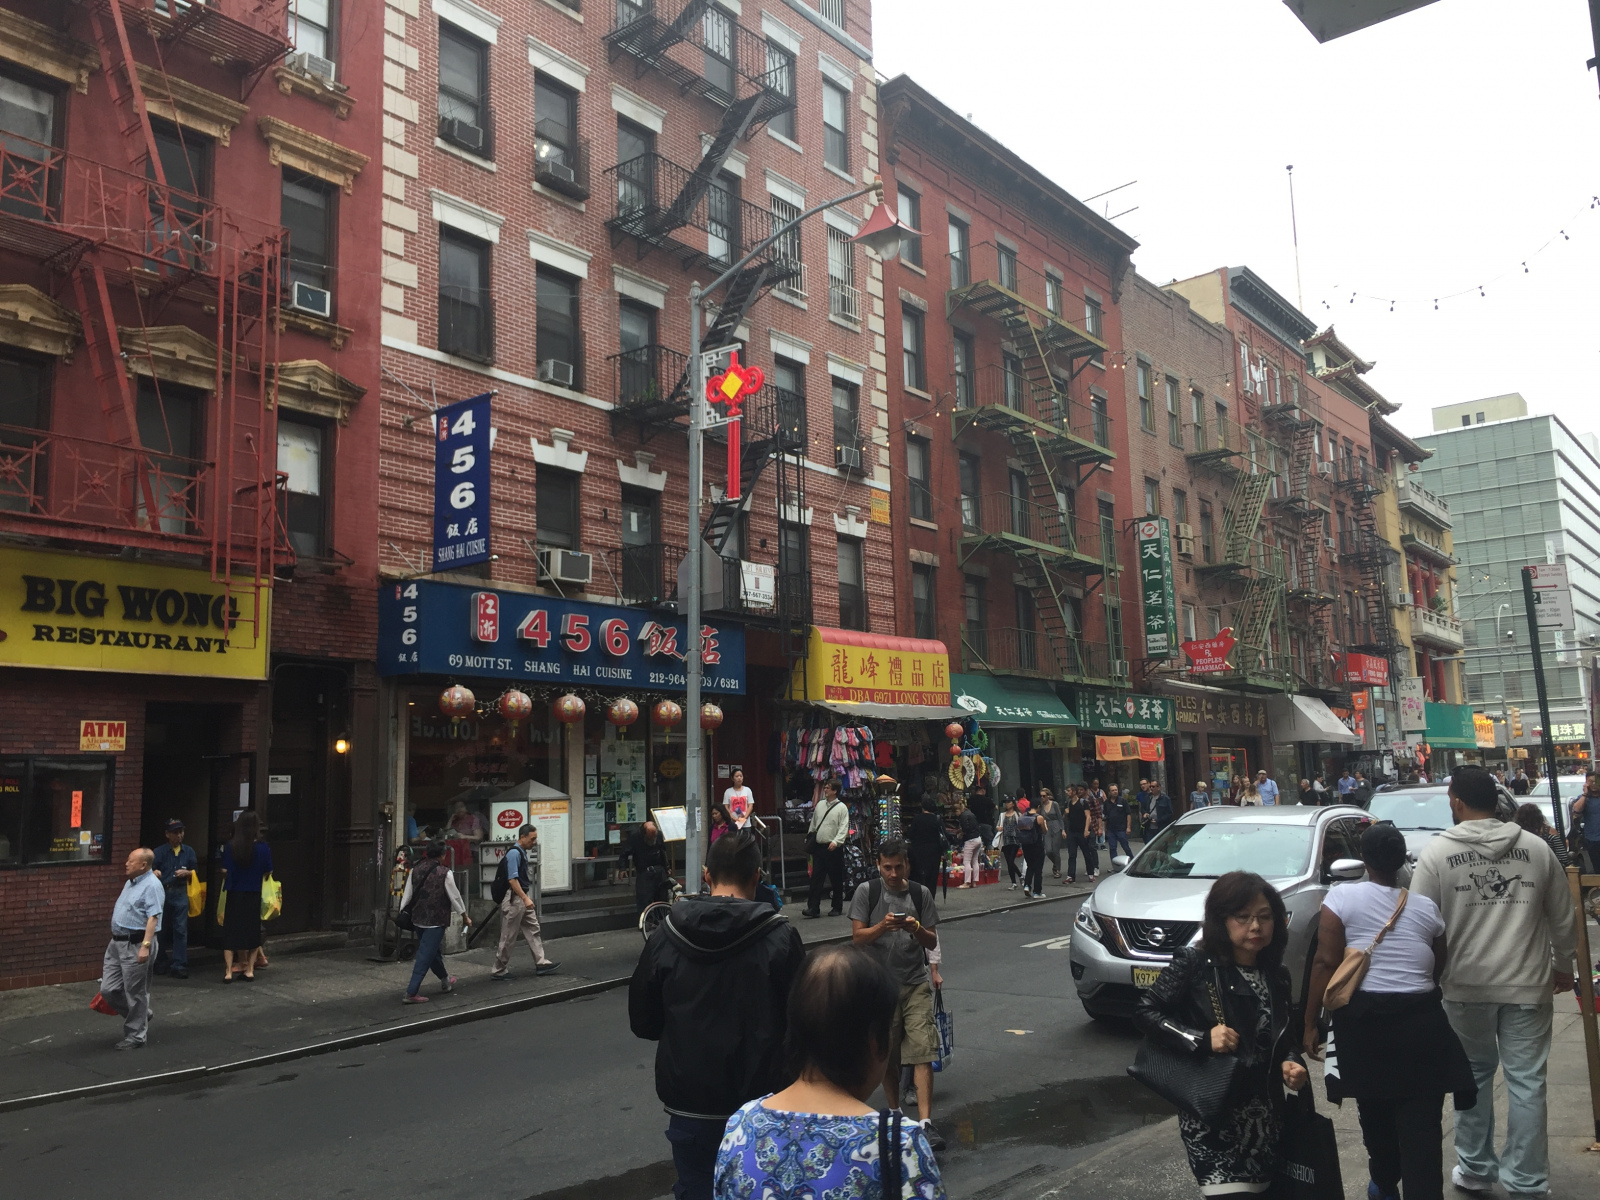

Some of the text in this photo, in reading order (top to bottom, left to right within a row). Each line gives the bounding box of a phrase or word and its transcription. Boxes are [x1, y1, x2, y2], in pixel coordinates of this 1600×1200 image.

[438, 538, 486, 562] SHANG HAI CUISINE
[1142, 543, 1165, 630] 天仁茗茶
[21, 575, 241, 629] BIG WONG
[32, 624, 230, 654] RESTAURANT
[449, 654, 462, 668] 69
[465, 655, 496, 669] MOTT
[497, 658, 513, 671] ST.
[525, 660, 560, 674] SHANG
[573, 665, 591, 677] HAI
[596, 667, 632, 680] CUISINE
[831, 648, 944, 688] 龍峰禮品店
[1193, 663, 1226, 672] PHARMACY
[1195, 657, 1222, 665] PEOPLES
[849, 689, 949, 705] DBA 6971 LONG STORE
[82, 722, 125, 738] ATM
[1447, 851, 1475, 869] TRUE
[1454, 884, 1471, 892] WORLD
